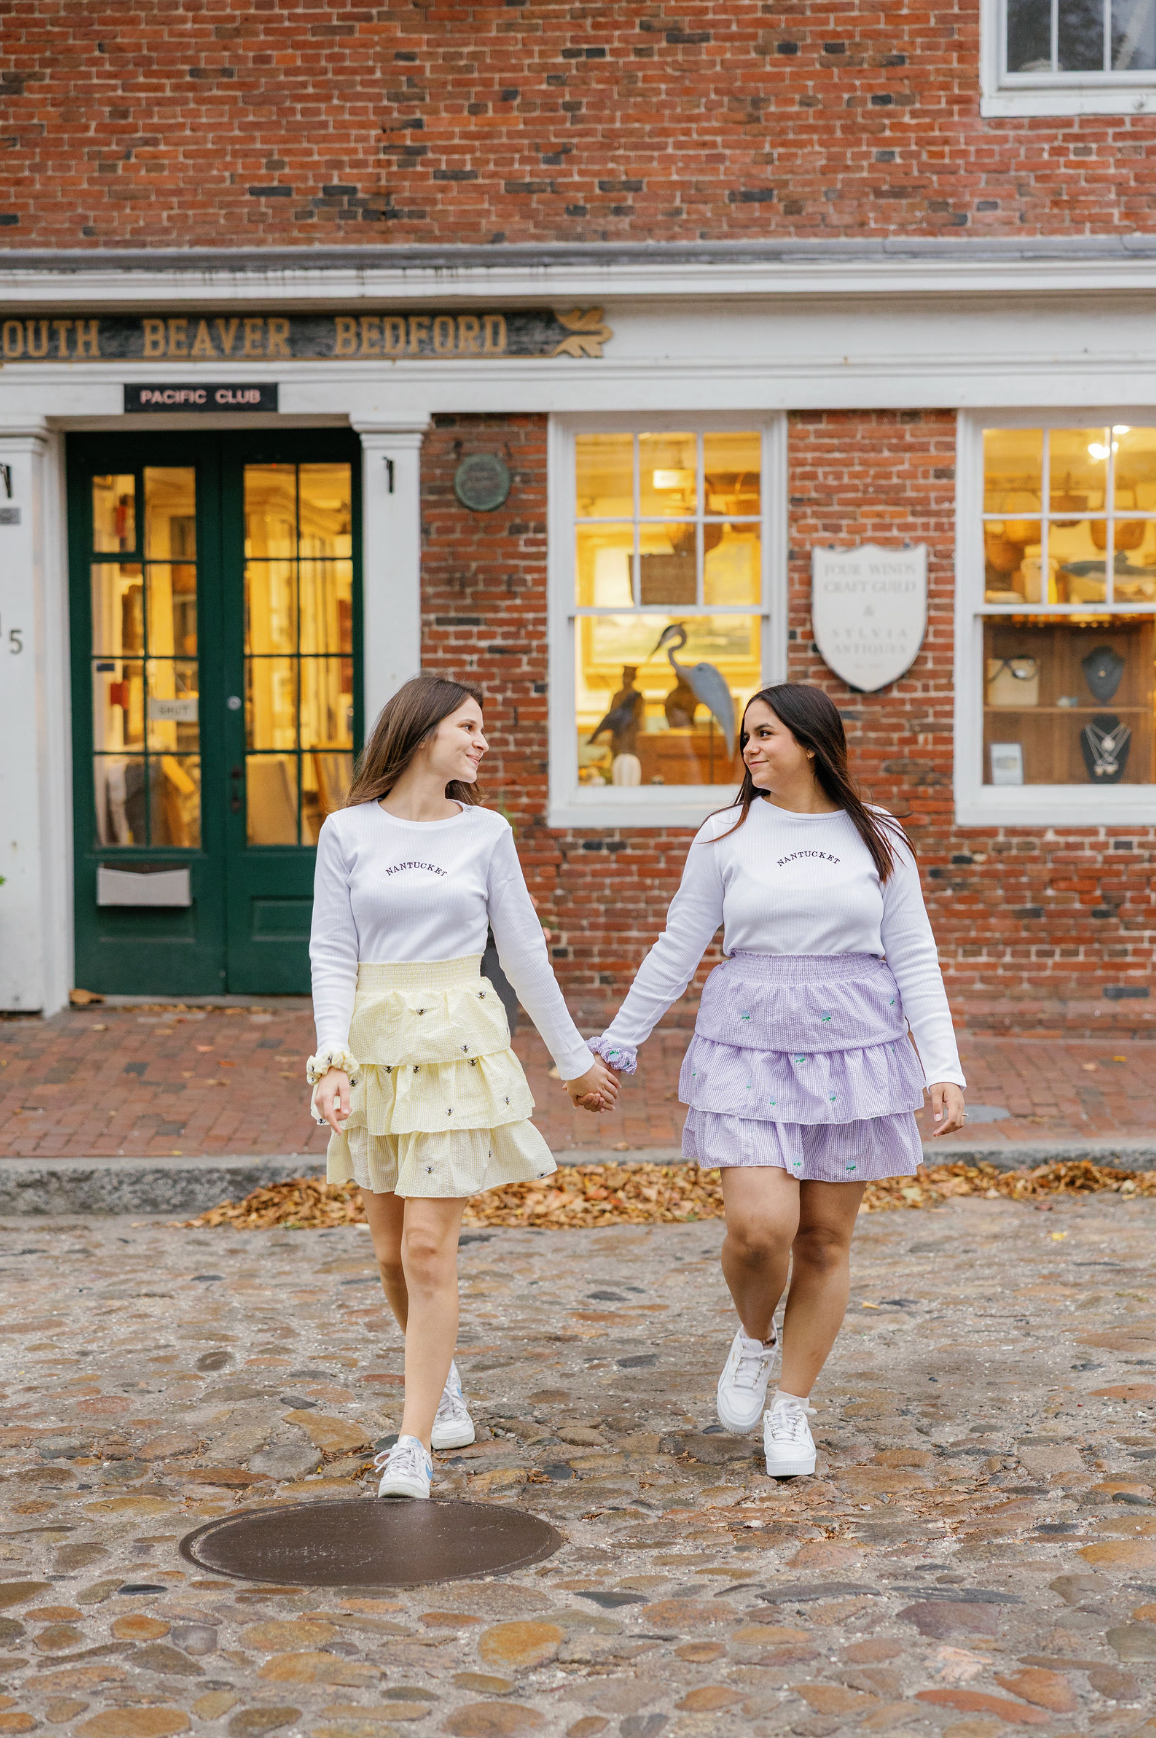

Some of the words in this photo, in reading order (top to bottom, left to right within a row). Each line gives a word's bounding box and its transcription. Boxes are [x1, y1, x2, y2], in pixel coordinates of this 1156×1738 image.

[141, 317, 292, 357] BEAVER
[333, 314, 508, 355] BEDFORD
[140, 389, 207, 405] PACIFIC
[215, 389, 261, 404] CLUB
[824, 562, 861, 576] FOUR
[868, 562, 917, 576] WINDS
[823, 580, 869, 594] CRAFT
[871, 580, 917, 594] GUILD
[777, 851, 840, 867] NANTUCKET
[385, 861, 448, 877] NANTUCKET
